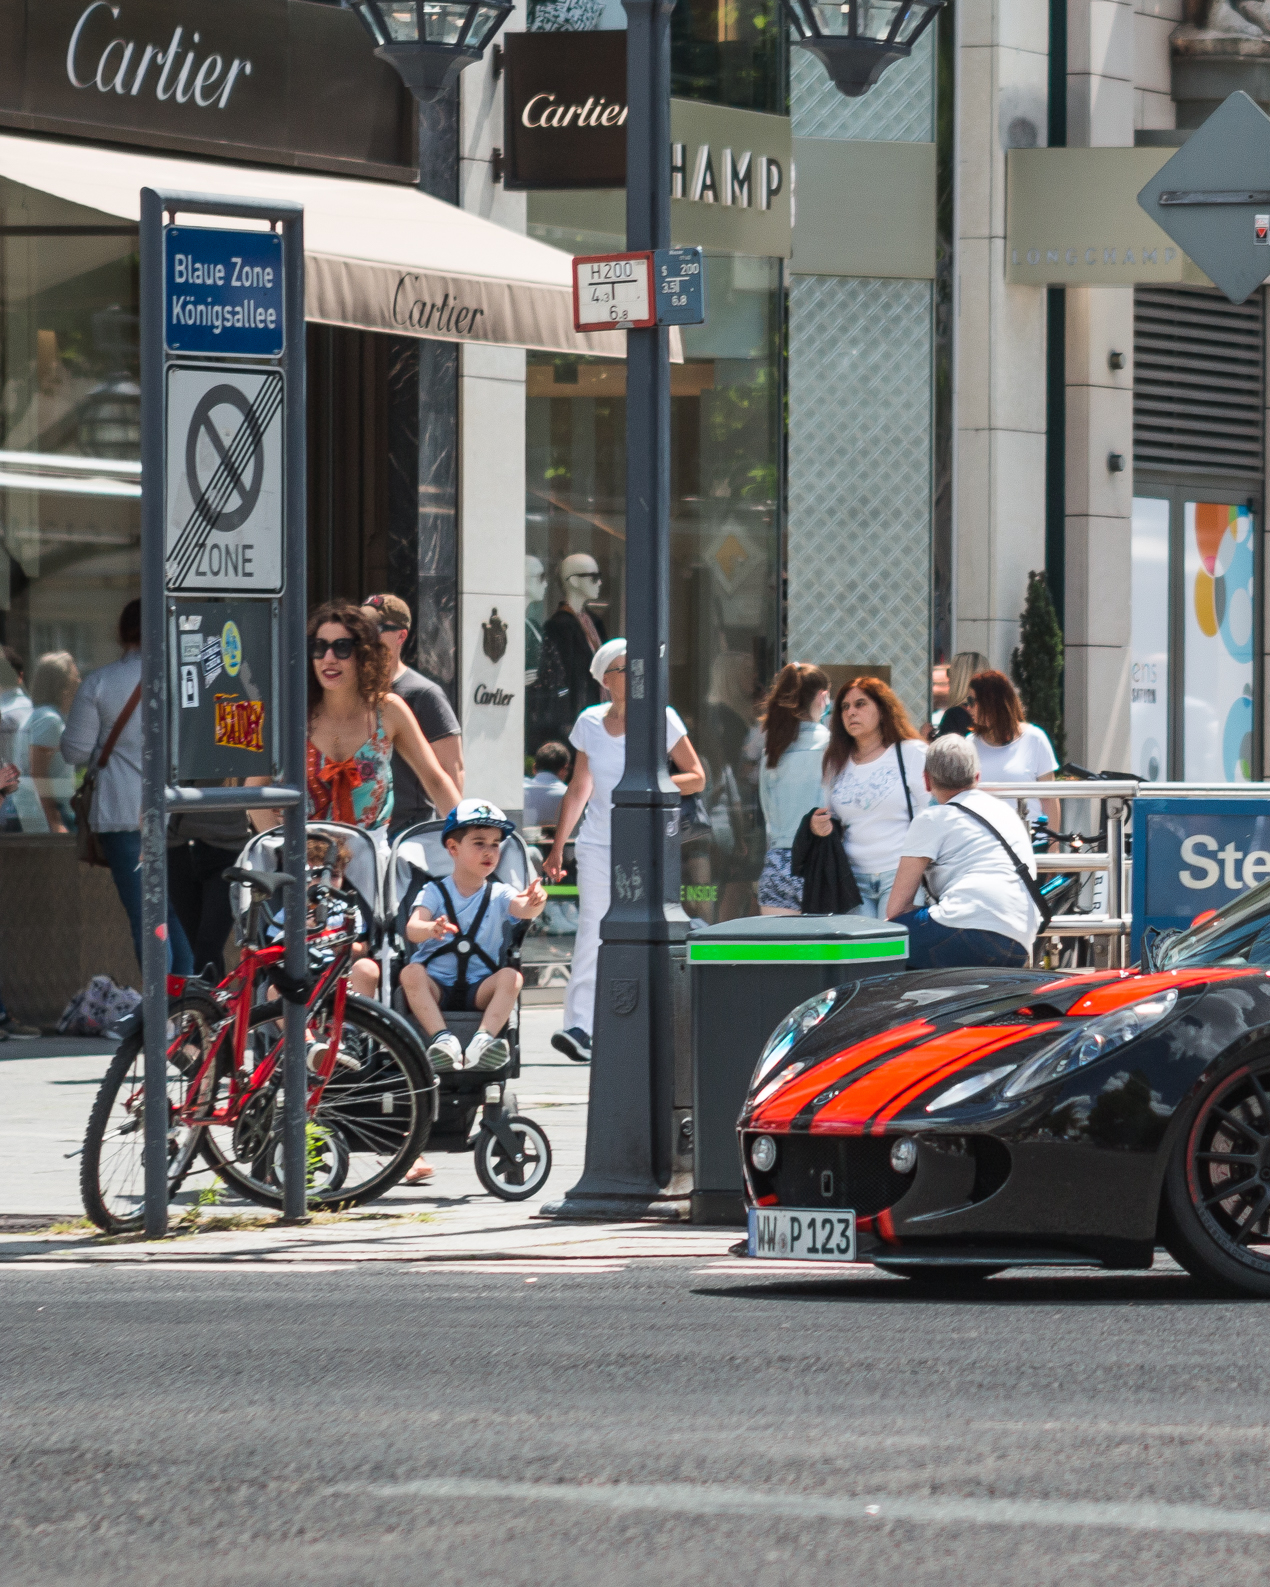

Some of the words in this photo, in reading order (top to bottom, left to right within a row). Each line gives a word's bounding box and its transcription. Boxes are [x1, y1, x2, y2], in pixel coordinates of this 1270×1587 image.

[66, 1, 252, 109] Cartier
[173, 254, 227, 288] Blaue
[230, 257, 274, 290] Zone
[680, 263, 700, 275] 200
[1011, 247, 1178, 266] LONGCHAMP
[171, 293, 277, 335] Königsallee
[391, 272, 485, 335] Cartier
[195, 543, 254, 577] ZONE
[474, 683, 515, 706] Cartier
[756, 1214, 778, 1252] WW
